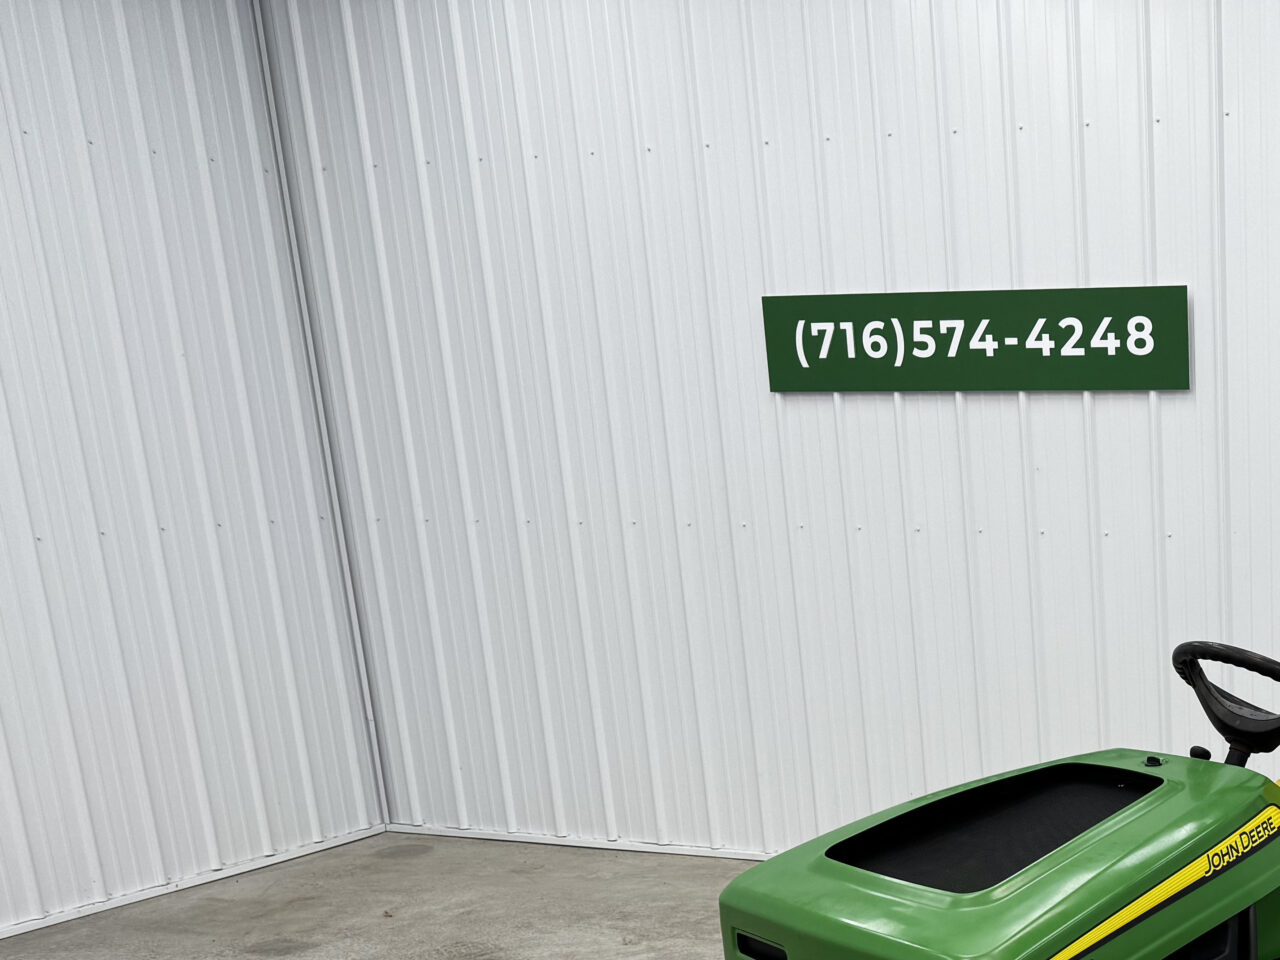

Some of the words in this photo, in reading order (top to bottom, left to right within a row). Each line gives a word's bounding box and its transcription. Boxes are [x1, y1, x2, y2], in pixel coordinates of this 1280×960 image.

[794, 315, 1155, 368] (716)574-4248
[1204, 840, 1241, 875] JOHN
[1239, 816, 1276, 851] DEERE
